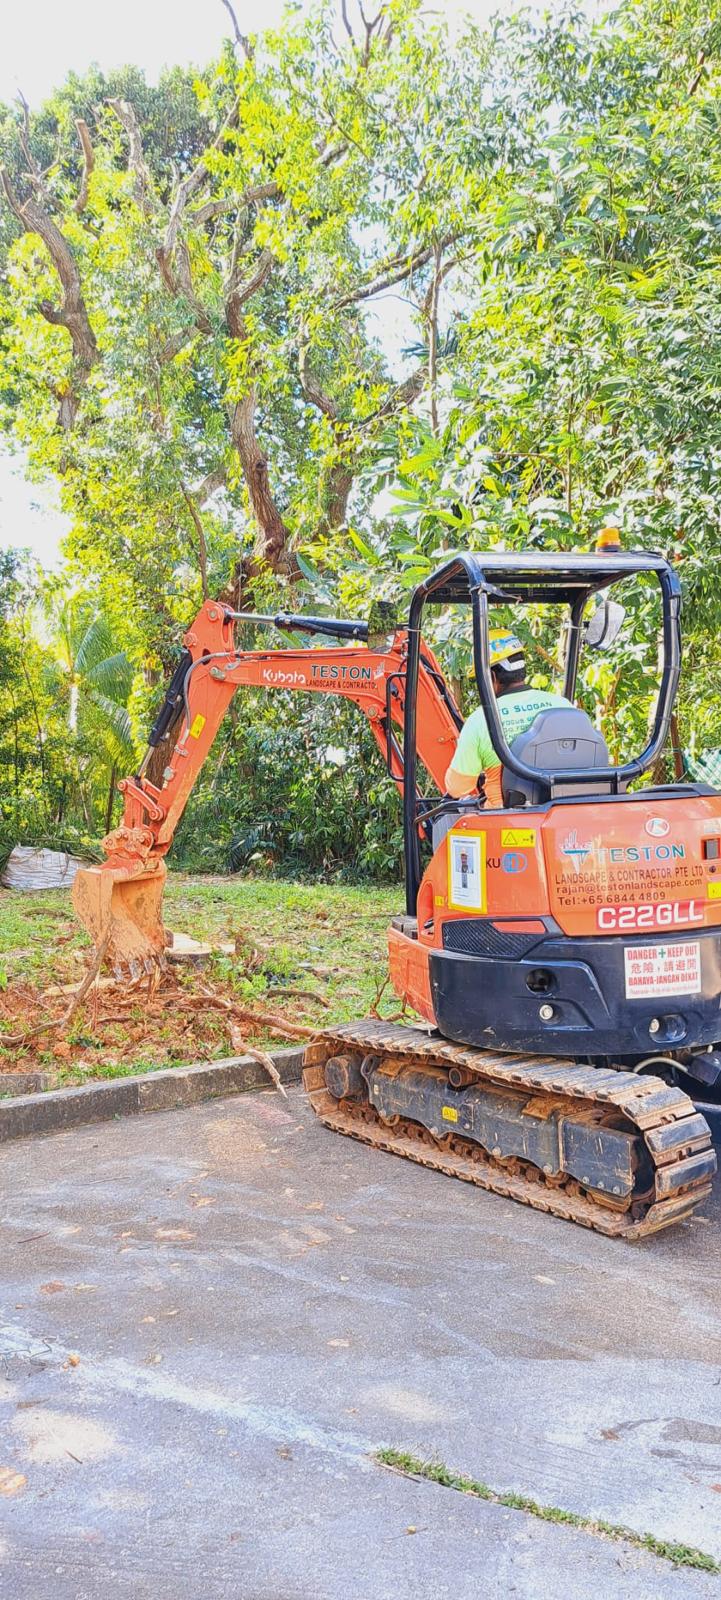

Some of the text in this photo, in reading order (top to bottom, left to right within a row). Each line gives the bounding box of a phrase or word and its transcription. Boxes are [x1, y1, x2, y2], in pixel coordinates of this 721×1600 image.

[311, 665, 371, 680] TESTON
[306, 680, 336, 688] LANDSCAPE
[342, 681, 378, 690] CONTRACTO
[594, 844, 685, 864] TESTON
[555, 865, 703, 884] LANDSCAPE & CONTRACTOR PTE LTD
[556, 878, 703, 895] rajan@testonlandscape.com
[607, 894, 635, 904] 6844
[640, 892, 666, 901] 4809
[598, 900, 704, 929] C22GLL
[627, 945, 697, 960] DANGER KEEP OUT
